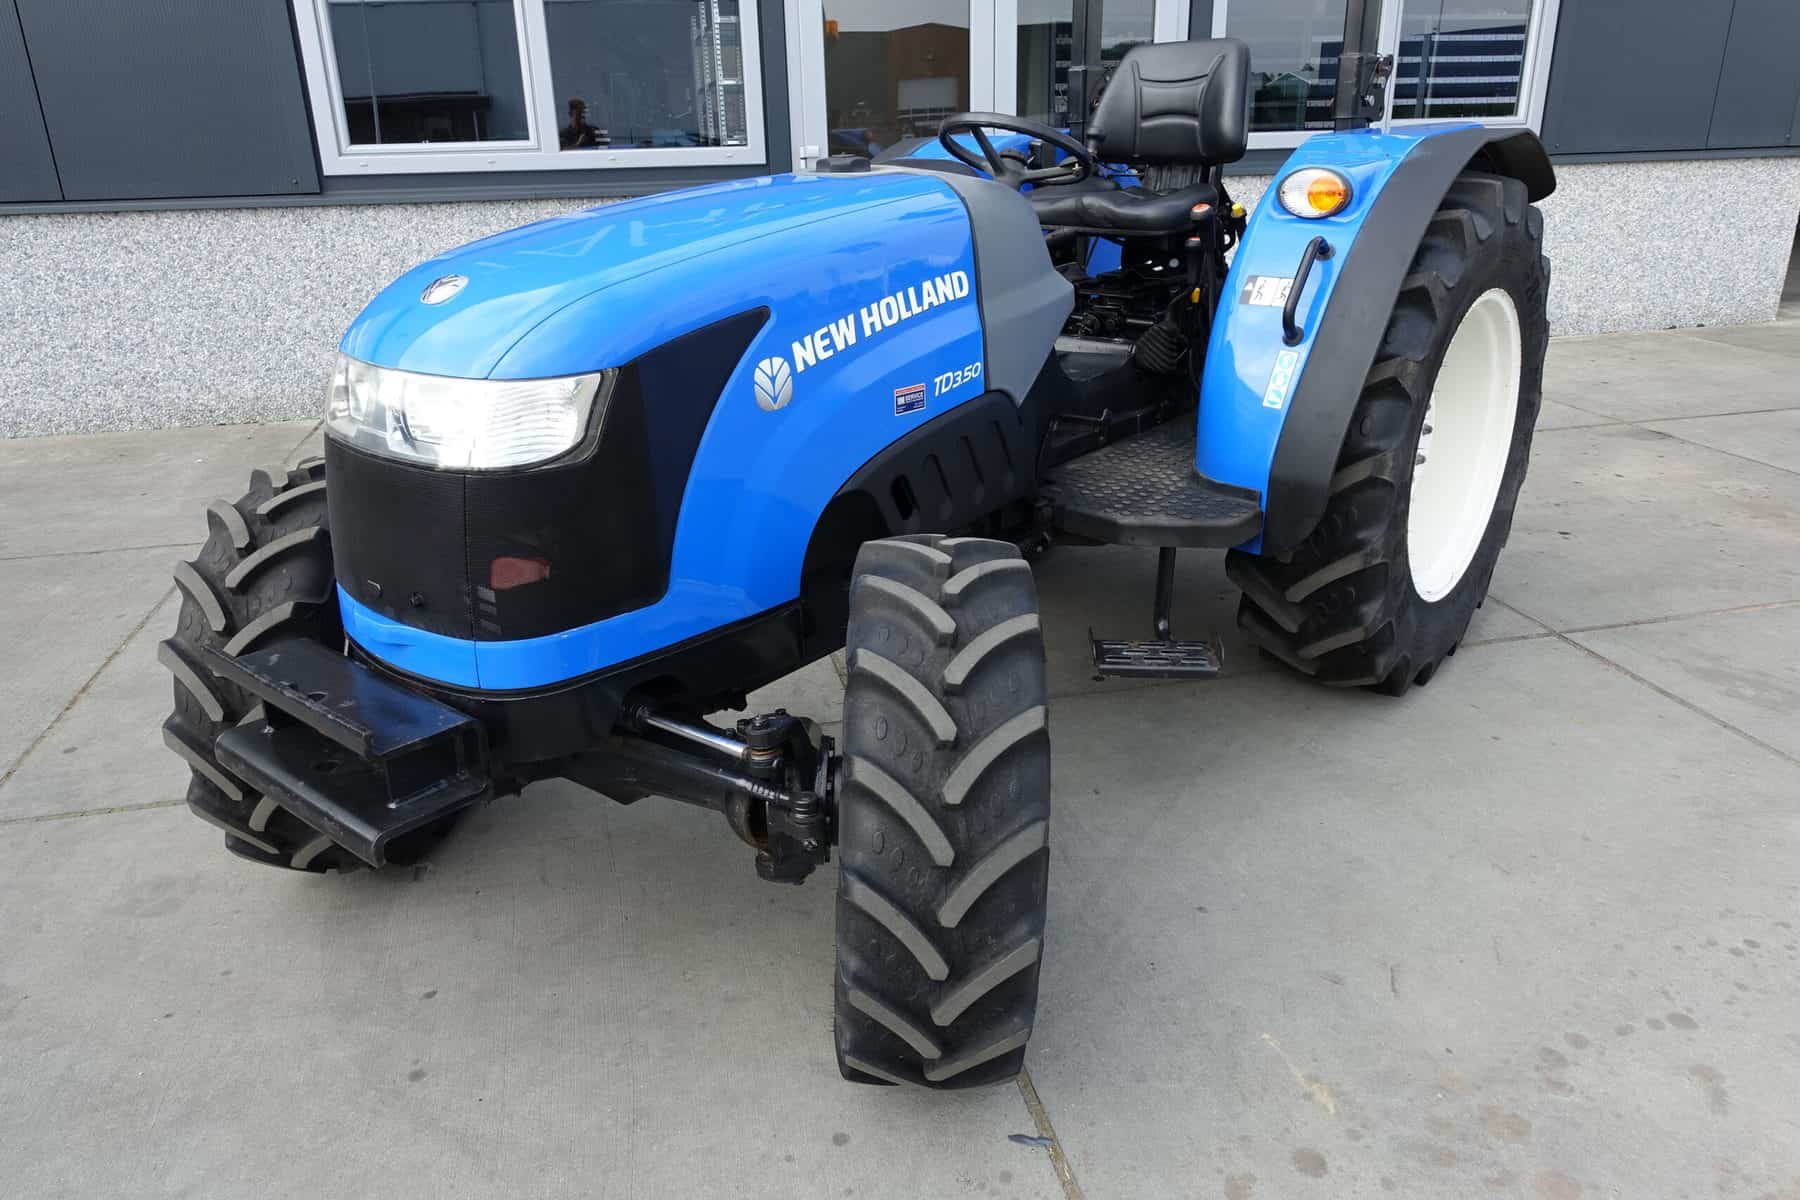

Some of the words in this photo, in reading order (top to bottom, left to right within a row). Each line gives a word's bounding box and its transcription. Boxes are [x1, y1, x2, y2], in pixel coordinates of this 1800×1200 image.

[791, 313, 857, 374] NEW
[860, 270, 970, 338] HOLLAND
[934, 362, 981, 397] TD3.50
